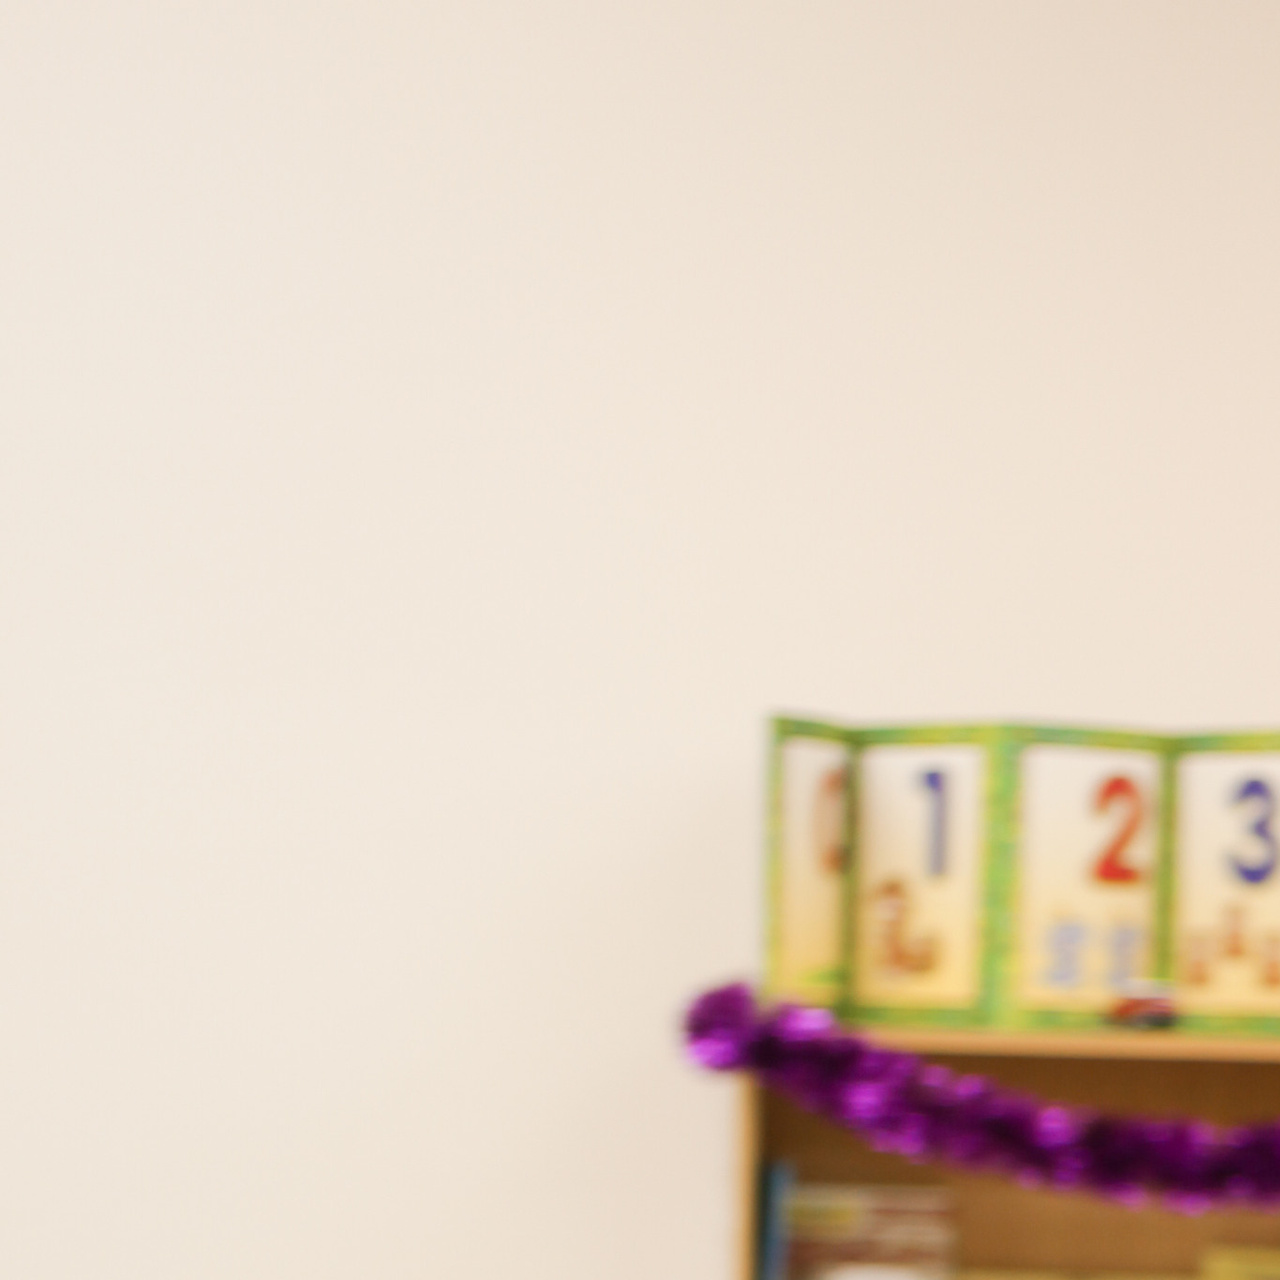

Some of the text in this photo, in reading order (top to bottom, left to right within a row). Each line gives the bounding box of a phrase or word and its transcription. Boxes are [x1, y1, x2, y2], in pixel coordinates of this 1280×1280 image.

[919, 769, 948, 877] 1
[1092, 775, 1147, 884] 2
[1229, 779, 1280, 884] 3
